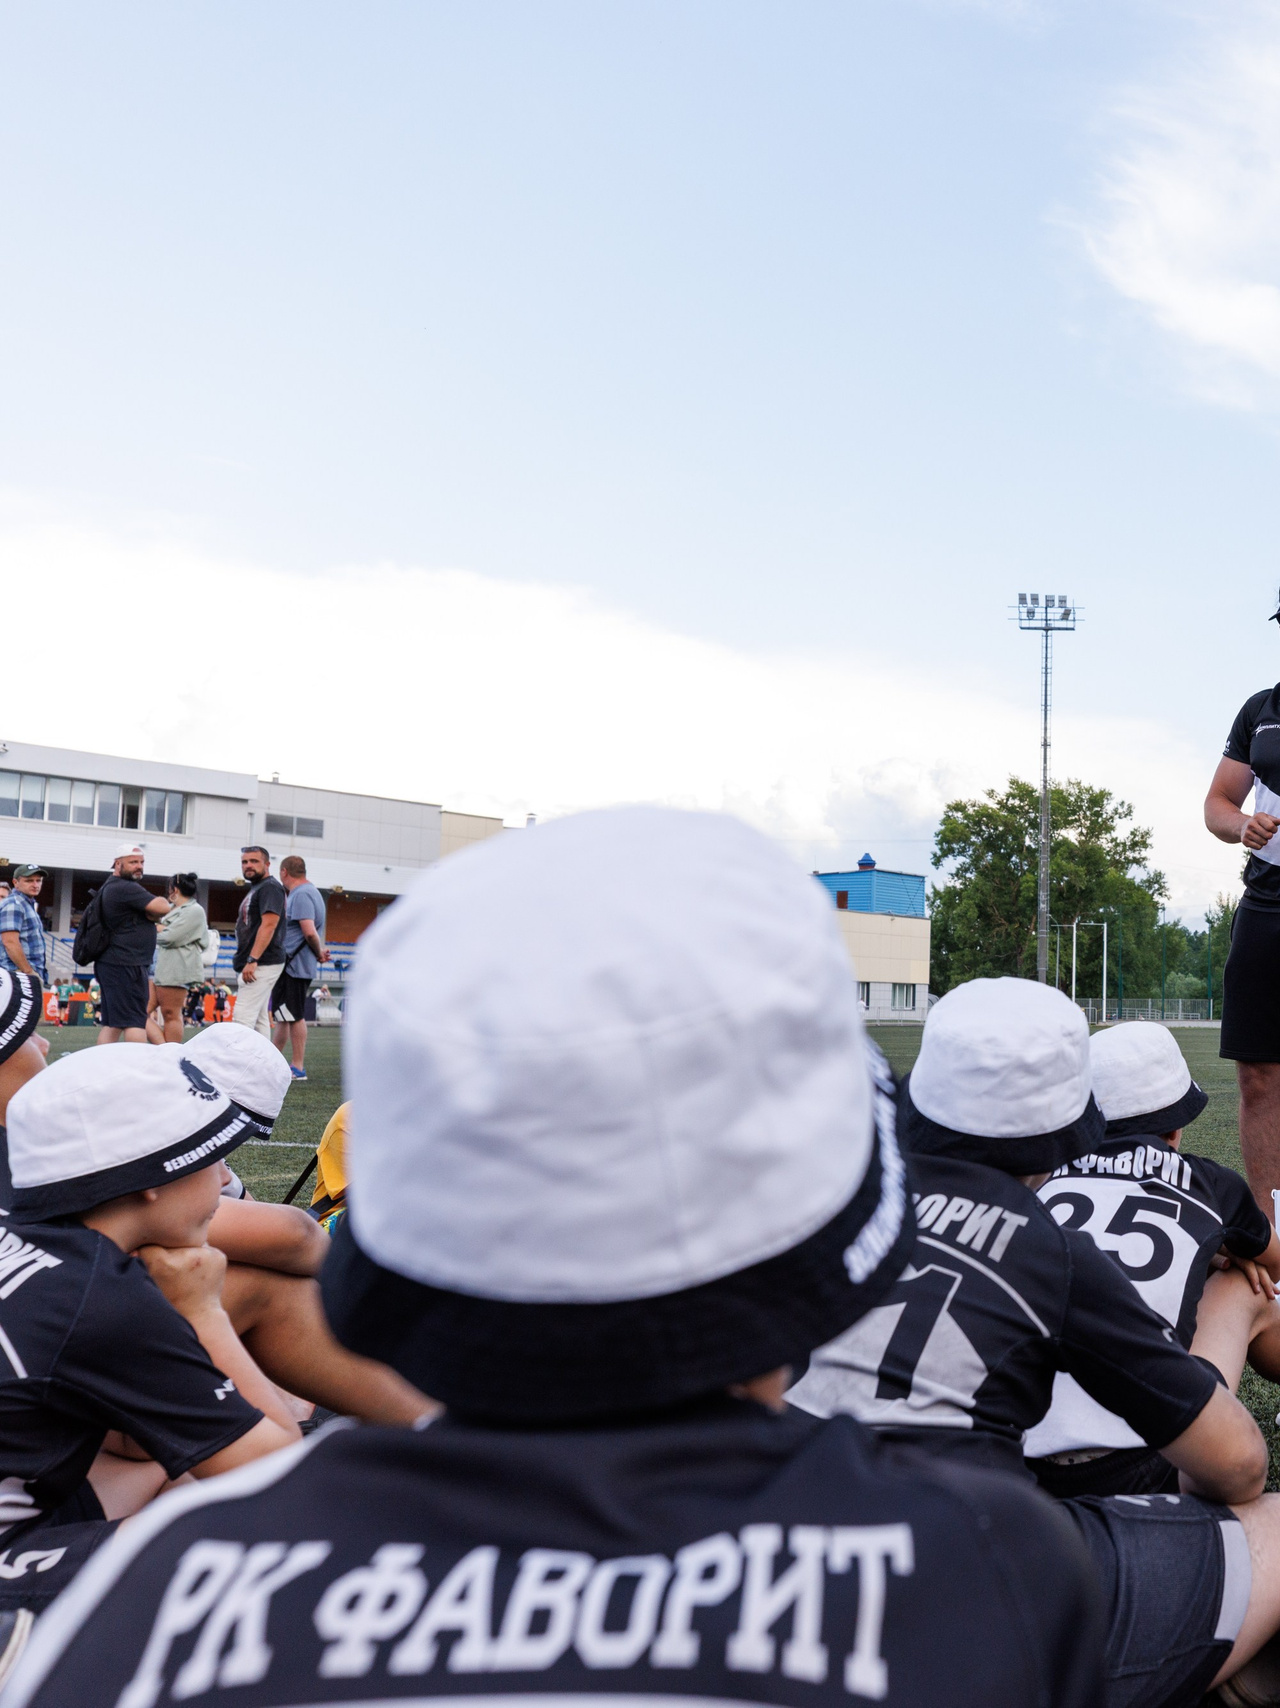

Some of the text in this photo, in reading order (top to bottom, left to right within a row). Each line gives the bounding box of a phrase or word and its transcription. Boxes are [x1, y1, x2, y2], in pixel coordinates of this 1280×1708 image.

[912, 1192, 1029, 1263] ОРИТ
[112, 1522, 916, 1708] РК ФАВОРИТ
